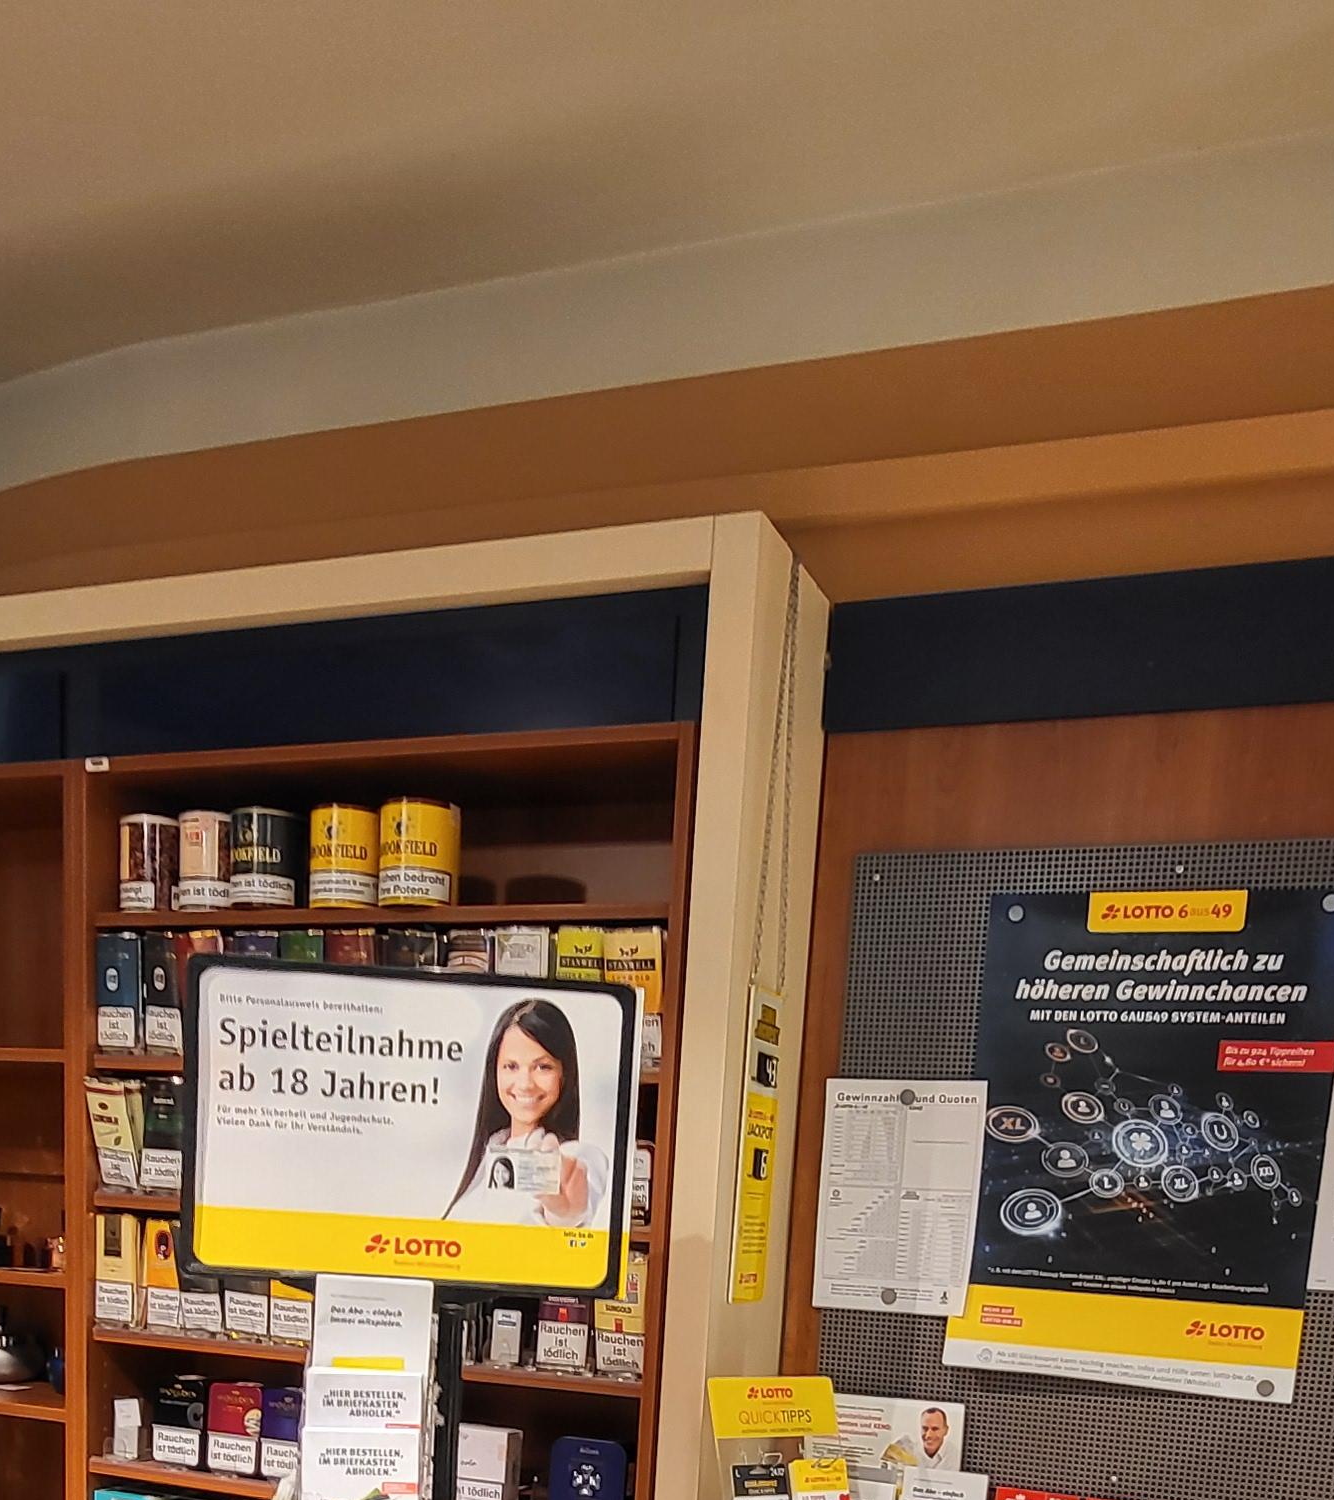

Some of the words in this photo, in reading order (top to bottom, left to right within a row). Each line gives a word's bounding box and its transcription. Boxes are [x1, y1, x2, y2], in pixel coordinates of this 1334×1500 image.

[405, 872, 445, 886] bedroht
[1123, 904, 1174, 919] LOTTO
[1044, 949, 1249, 977] Gemeinschaftlich
[1252, 952, 1285, 972] zu
[1015, 978, 1111, 1000] höheren
[1115, 980, 1308, 1002] Gewinnchancen
[246, 996, 319, 1009] Personalausweis
[1029, 1009, 1052, 1022] MIT
[1054, 1010, 1079, 1022] DEN
[1080, 1010, 1118, 1023] LOTTO
[1120, 1011, 1168, 1023] 6AUS49
[1170, 1012, 1286, 1025] SYSTEM-ANTEILEN
[219, 1016, 464, 1063] Spielteilnahme
[1269, 1047, 1315, 1058] Tippreihen
[1222, 1056, 1236, 1068] für
[218, 1062, 256, 1093] ab
[271, 1068, 309, 1096] 18
[321, 1068, 439, 1104] Jahren!
[837, 1092, 900, 1103] Gewinnzahl
[261, 1107, 307, 1119] Sicherheit
[330, 1112, 394, 1125] Jugendschutz.
[307, 1122, 363, 1135] Verständnis.
[1000, 1116, 1026, 1131] XL
[1214, 1124, 1229, 1139] U
[1259, 1166, 1274, 1177] XXL
[1172, 1177, 1188, 1190] XL
[394, 1237, 462, 1258] LOTTO
[540, 1323, 586, 1337] Rauchen
[1209, 1324, 1265, 1340] LOTTO
[597, 1334, 644, 1348] Rauchen
[543, 1347, 579, 1361] tödlich
[761, 1388, 793, 1399] LOTTO
[739, 1409, 812, 1425] QUICKTIPPS
[158, 1431, 195, 1445] Rauchen
